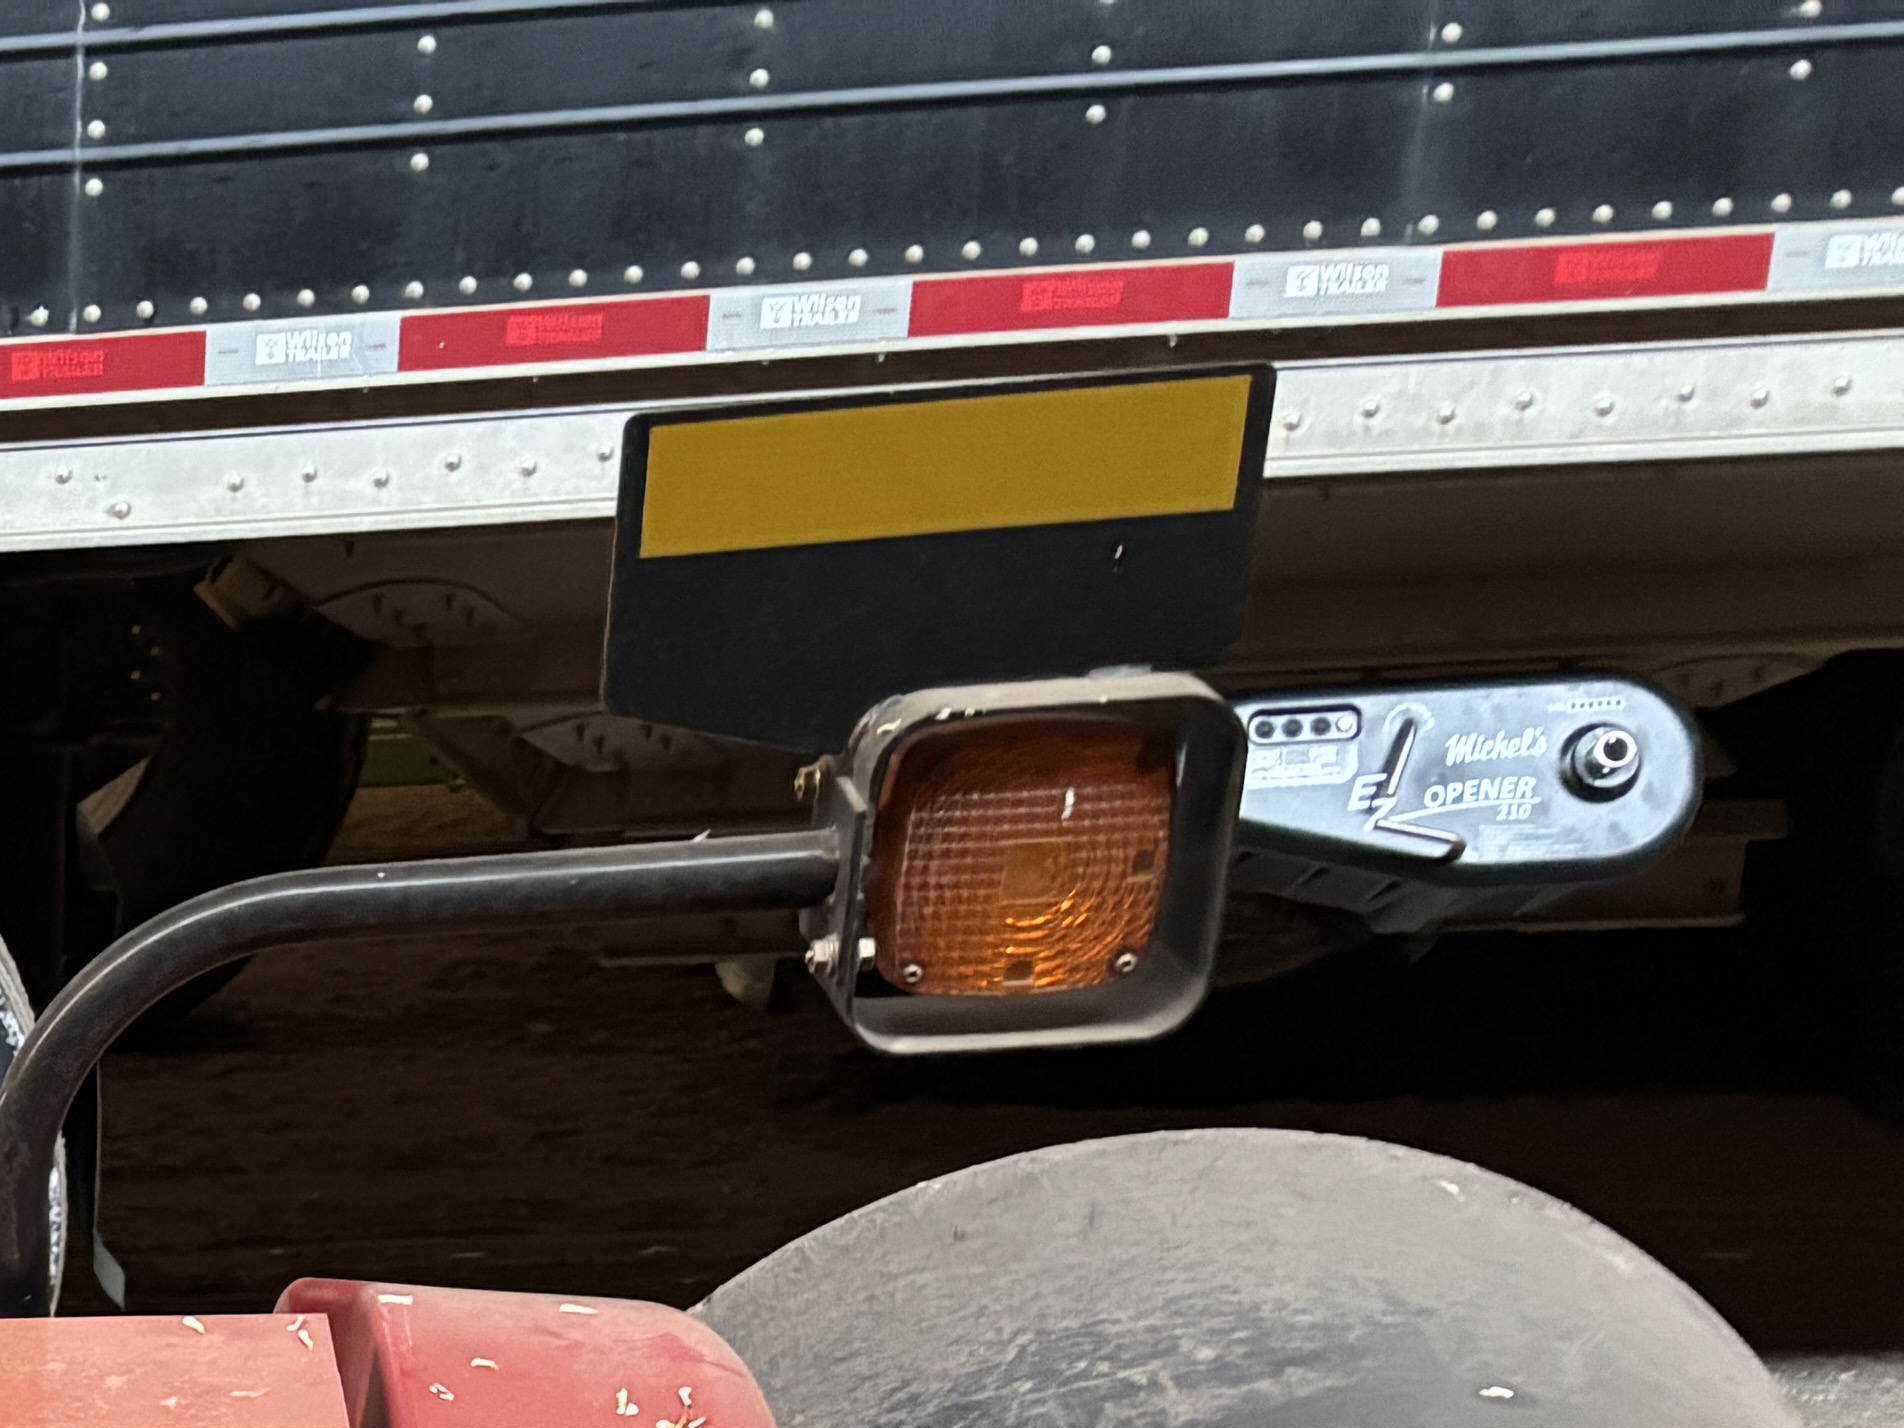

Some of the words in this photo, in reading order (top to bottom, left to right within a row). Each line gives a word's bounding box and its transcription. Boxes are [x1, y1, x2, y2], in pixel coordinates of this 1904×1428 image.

[1320, 263, 1389, 281] Wilson
[794, 294, 861, 312] Wilson
[793, 310, 859, 327] TRAILER
[287, 330, 352, 347] Wilson
[287, 344, 351, 362] TRAILER
[1445, 727, 1548, 766] Michel's
[1424, 776, 1537, 808] OPENER
[1496, 803, 1532, 821] 210
